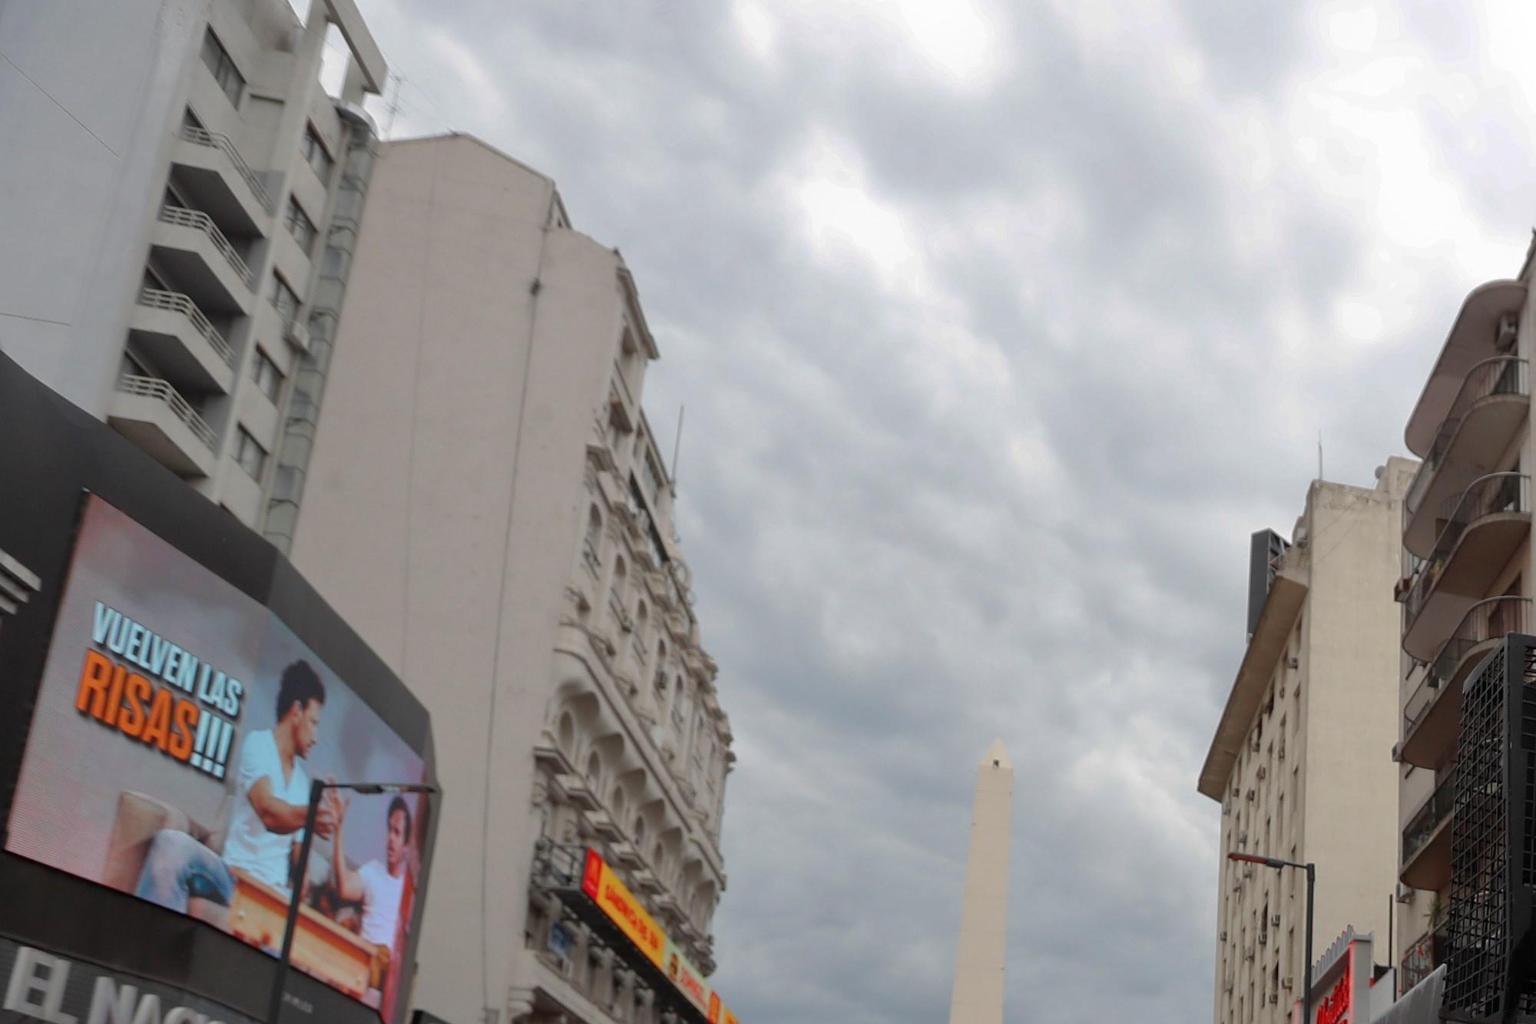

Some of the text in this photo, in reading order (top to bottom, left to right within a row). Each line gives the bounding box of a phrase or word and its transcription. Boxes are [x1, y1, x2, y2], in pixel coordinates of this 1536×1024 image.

[76, 648, 234, 779] RISAS!!!
[93, 601, 243, 717] VUELVEN LAS
